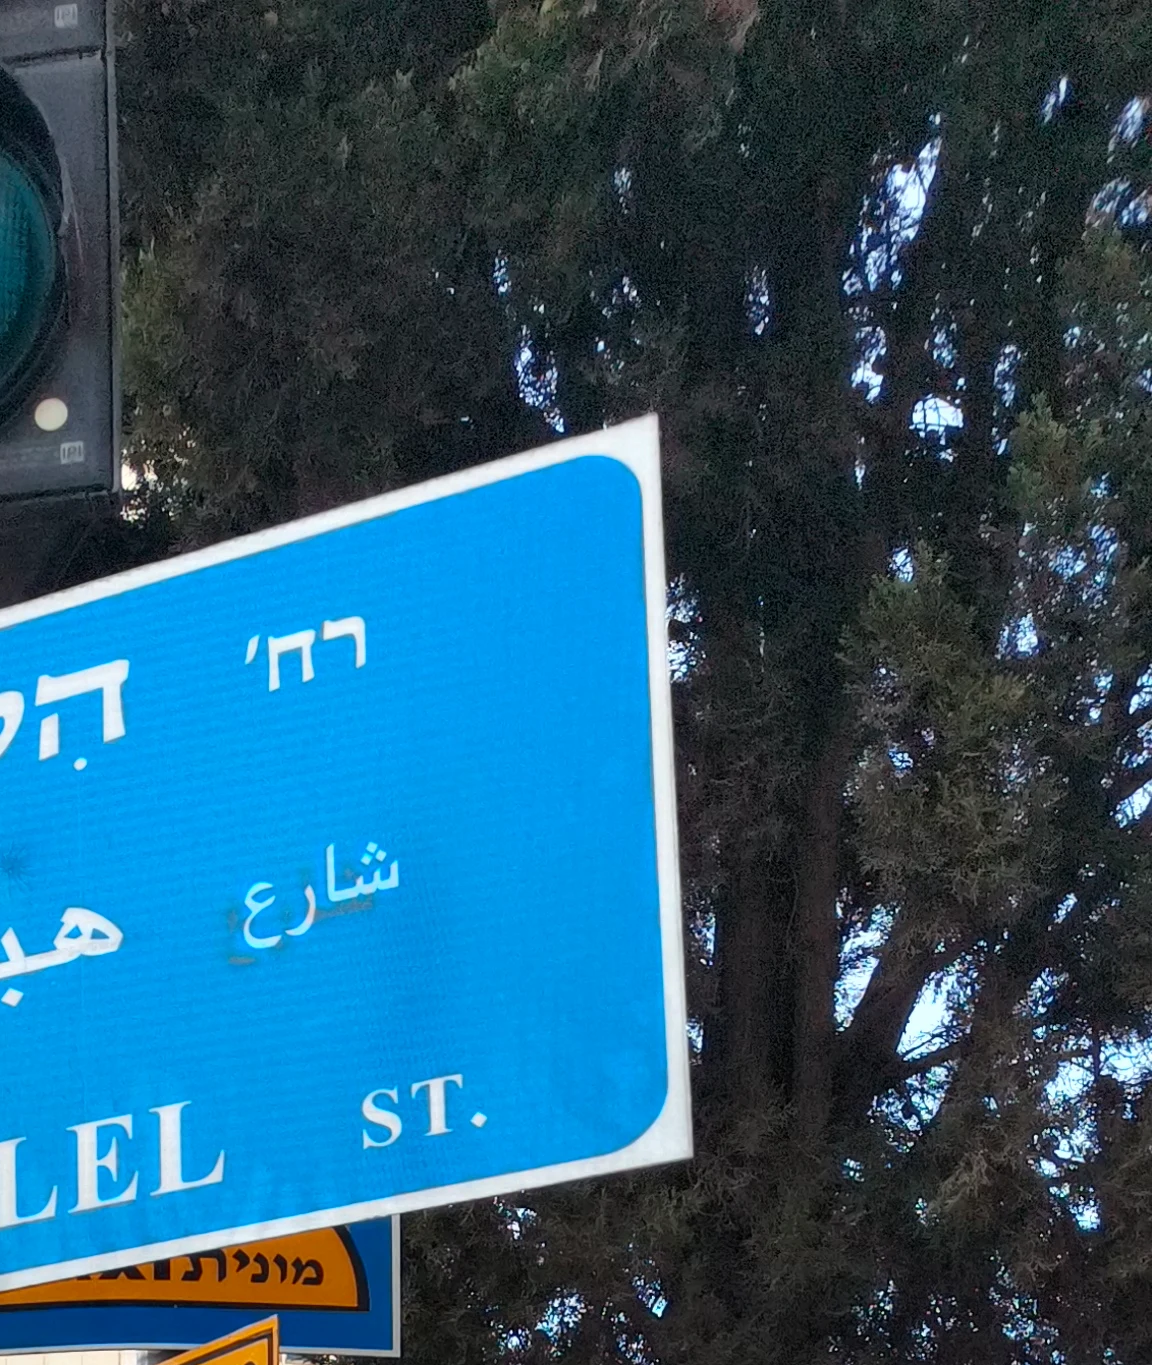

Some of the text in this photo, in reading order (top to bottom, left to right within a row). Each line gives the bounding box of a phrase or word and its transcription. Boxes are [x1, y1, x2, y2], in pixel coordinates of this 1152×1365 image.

[241, 841, 400, 948] شارع
[362, 1073, 488, 1149] ST.
[180, 1248, 324, 1286] מונית
